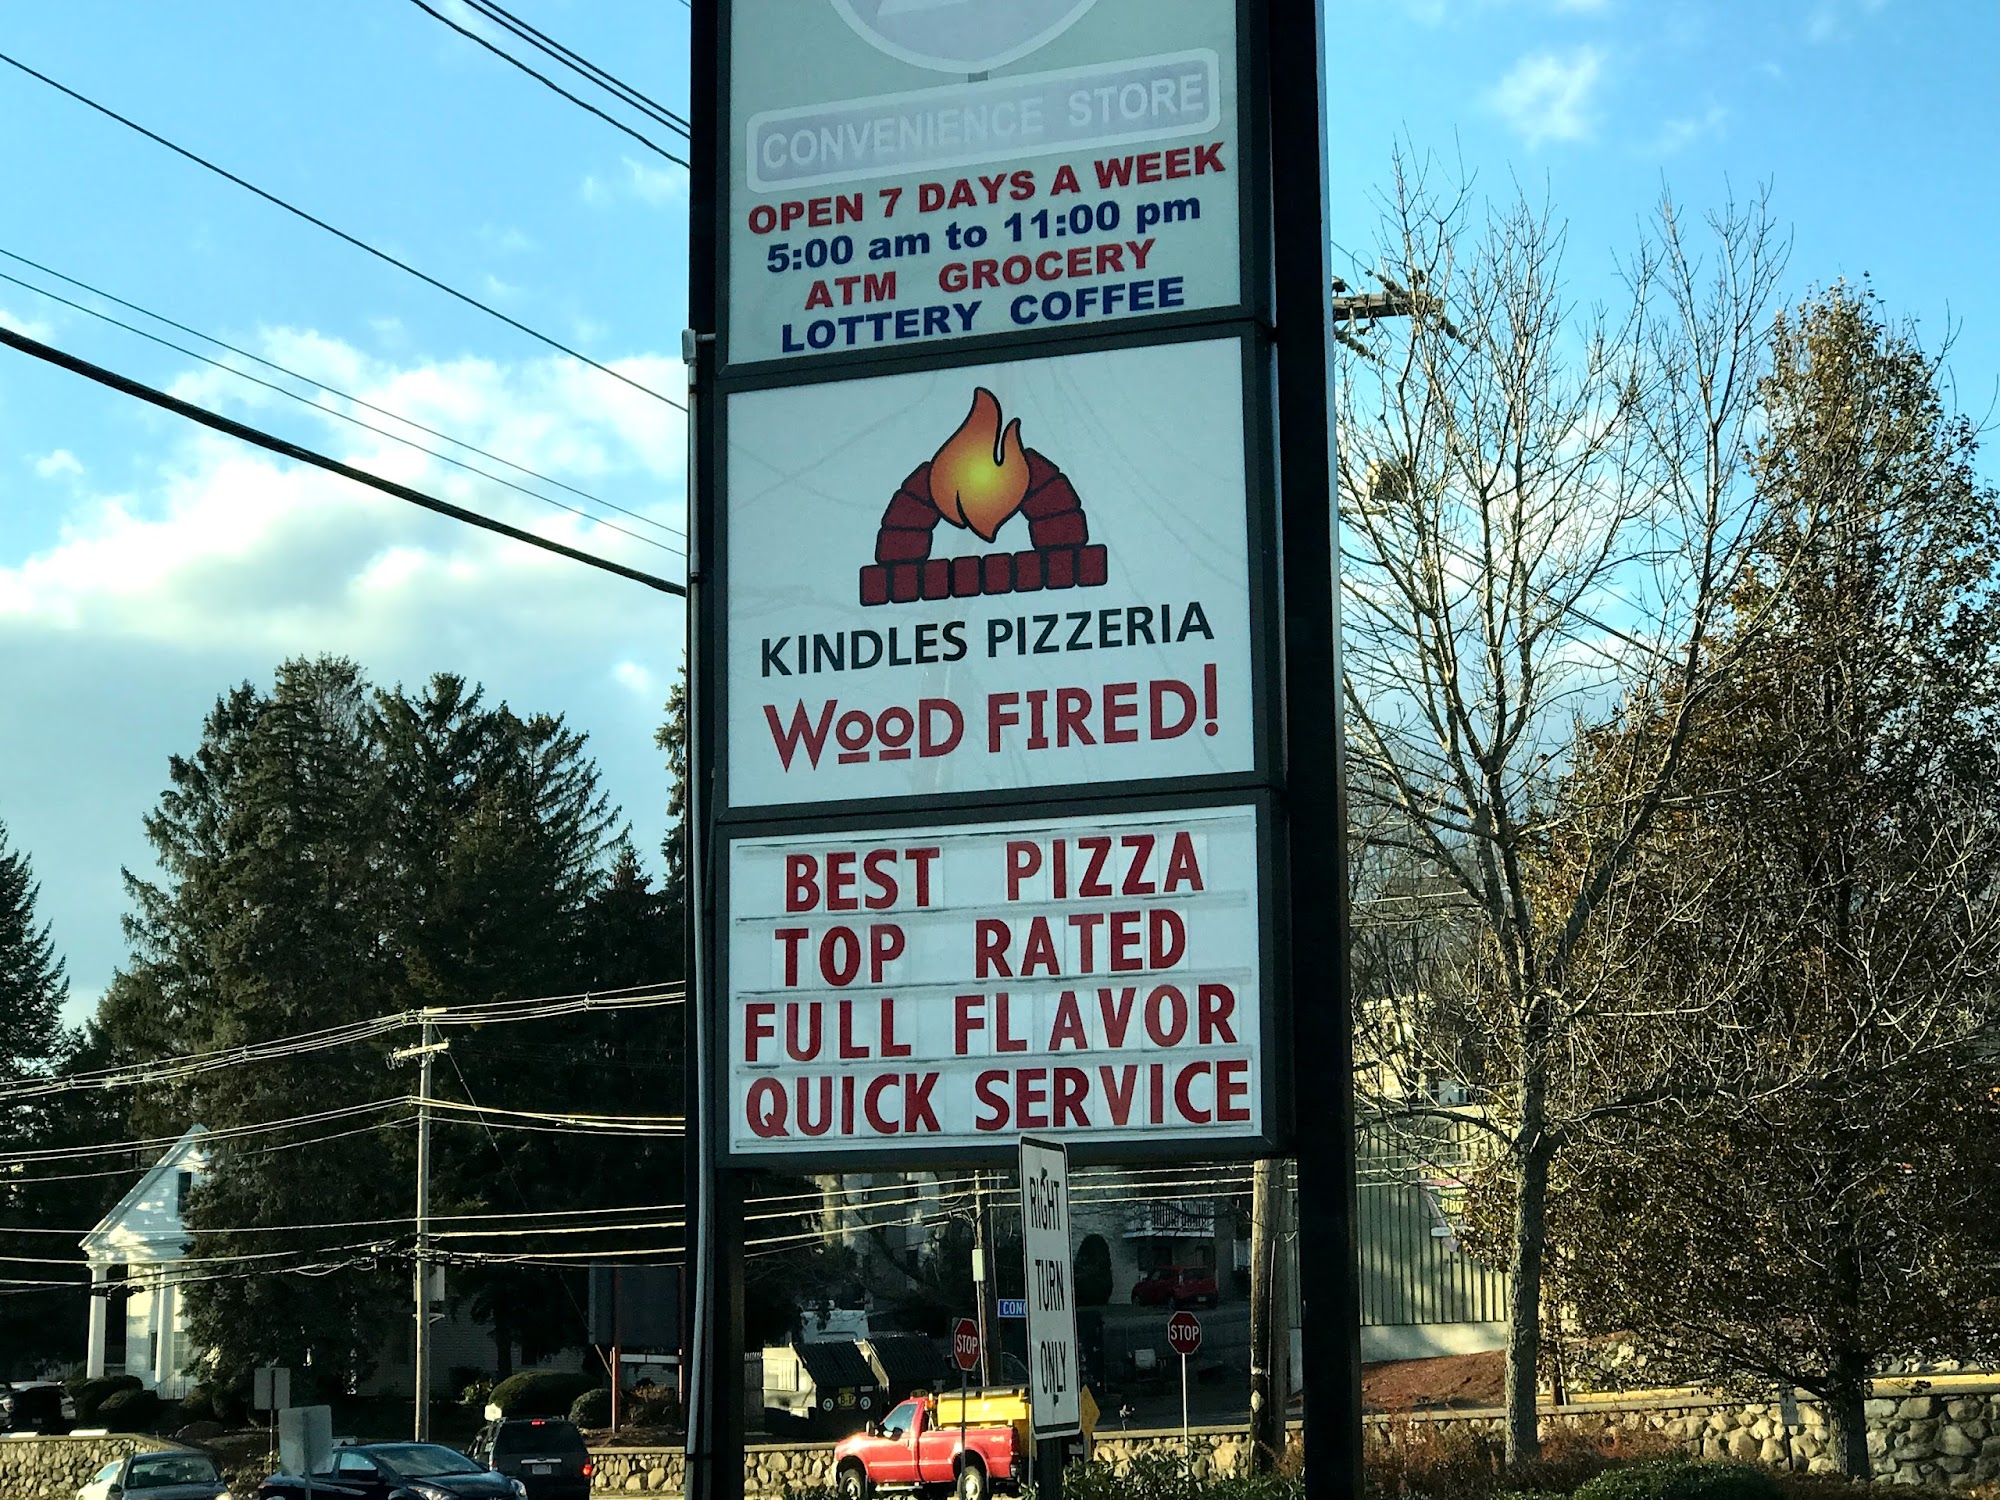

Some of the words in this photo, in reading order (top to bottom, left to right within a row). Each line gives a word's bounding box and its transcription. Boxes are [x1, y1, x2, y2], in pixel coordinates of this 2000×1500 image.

[762, 98, 1044, 170] CONVENIENCE
[1068, 73, 1204, 128] STORE
[748, 193, 863, 235] OPEN
[879, 187, 903, 218] 7
[919, 170, 1036, 213] DAYS
[1050, 165, 1082, 196] A
[1095, 141, 1226, 187] WEEK
[767, 235, 853, 273] 5:00
[868, 232, 930, 261] am
[946, 221, 987, 252] to
[1003, 201, 1120, 242] 11:00
[1136, 197, 1201, 235] pm
[805, 272, 897, 310] ATM
[938, 239, 1156, 294] GROCERY
[782, 301, 982, 353] LOTTERY
[1010, 276, 1185, 325] COFFEE
[761, 620, 967, 677] KINDLES
[988, 602, 1214, 658] PIZZERIA
[988, 663, 1219, 753] FIRED!
[785, 847, 940, 912] BEST
[1006, 831, 1204, 901] PIZZA
[775, 923, 905, 987] TOP
[975, 909, 1186, 979] RATED
[744, 997, 911, 1062] FULL
[954, 984, 1237, 1056] FLAVOR
[745, 1072, 941, 1137] QUICK
[975, 1060, 1250, 1132] SERVICE
[1029, 1176, 1061, 1231] RIGHT
[1035, 1259, 1065, 1311] TURN
[956, 1334, 978, 1354] STOP
[1040, 1341, 1067, 1394] ONLY
[1170, 1324, 1200, 1341] STOP
